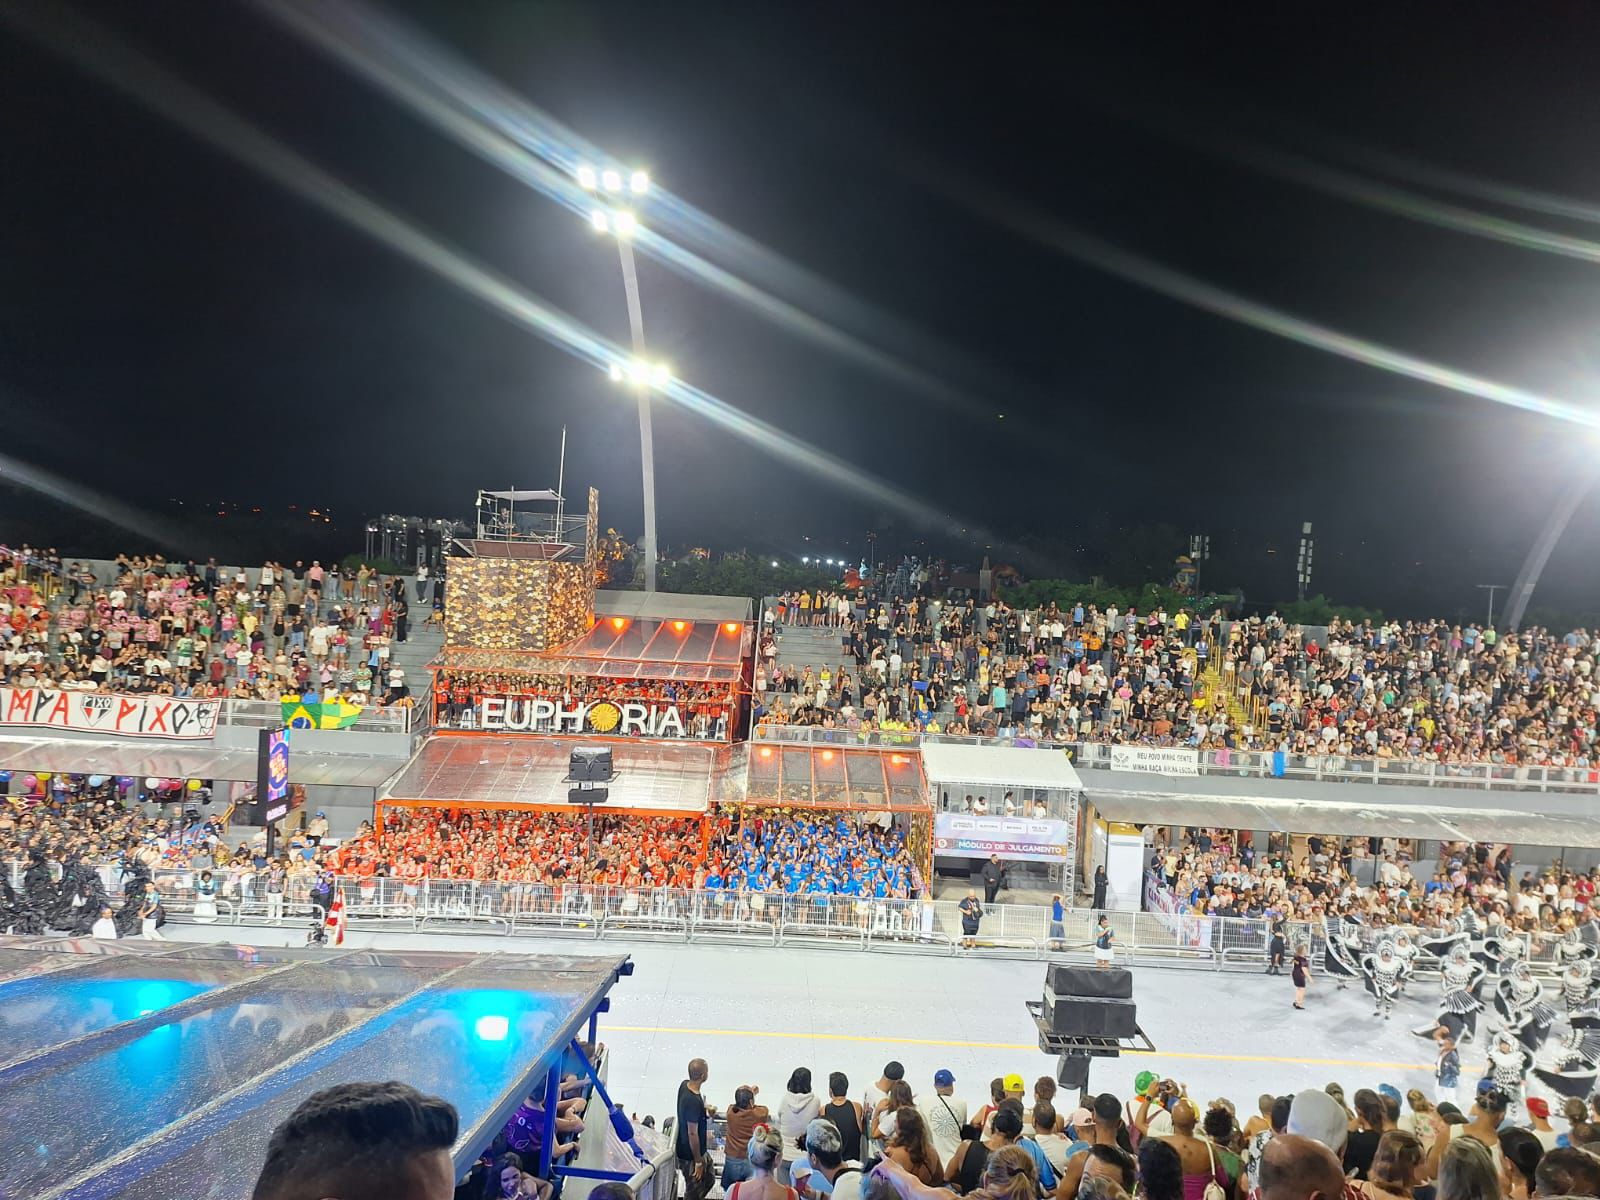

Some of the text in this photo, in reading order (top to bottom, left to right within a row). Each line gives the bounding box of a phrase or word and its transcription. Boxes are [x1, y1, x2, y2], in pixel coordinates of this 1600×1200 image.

[0, 688, 68, 724] MPA
[482, 698, 685, 736] EUPHORIA
[958, 839, 1062, 854] MÓDULO DE JULGAMENTO
